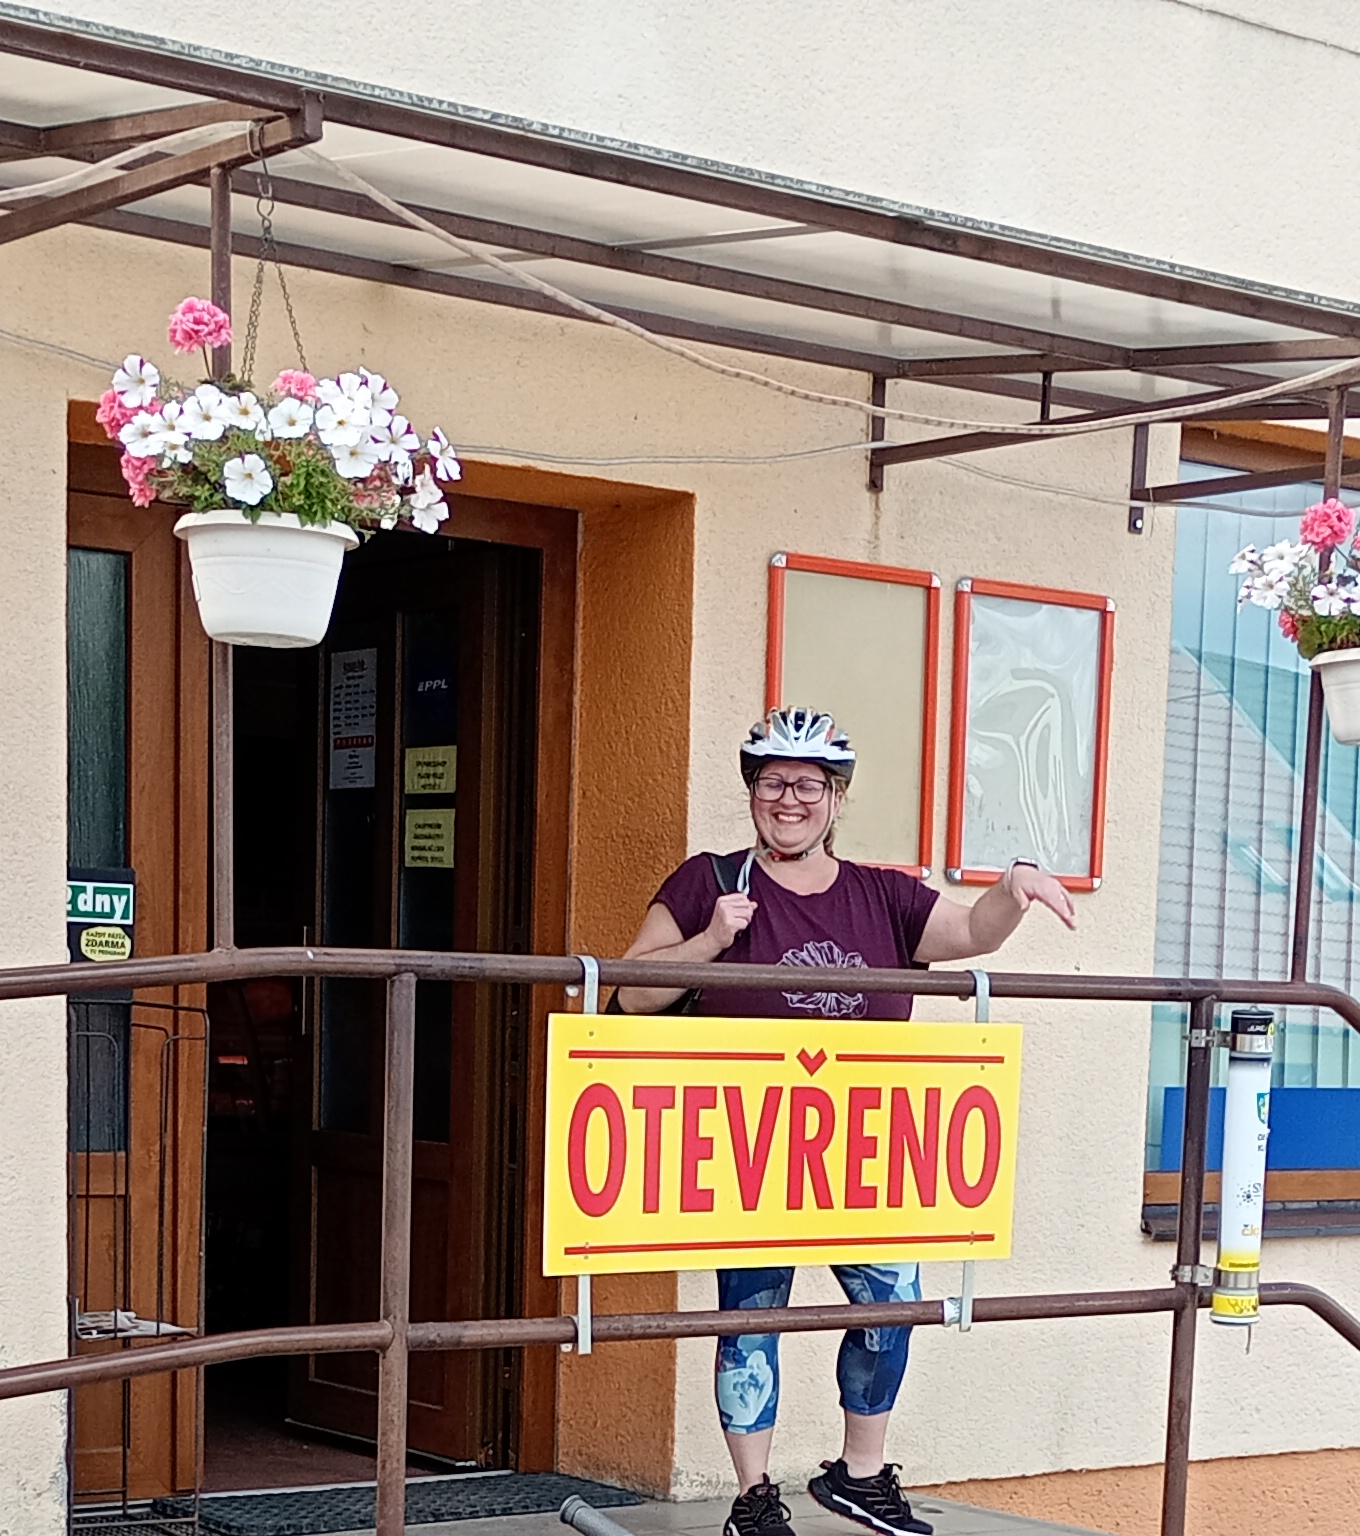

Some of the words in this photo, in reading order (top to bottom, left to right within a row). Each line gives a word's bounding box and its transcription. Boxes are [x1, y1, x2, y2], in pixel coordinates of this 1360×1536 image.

[77, 886, 128, 920] dny
[85, 938, 126, 949] ZDARMA
[567, 1047, 1002, 1218] OTEVŘENO
